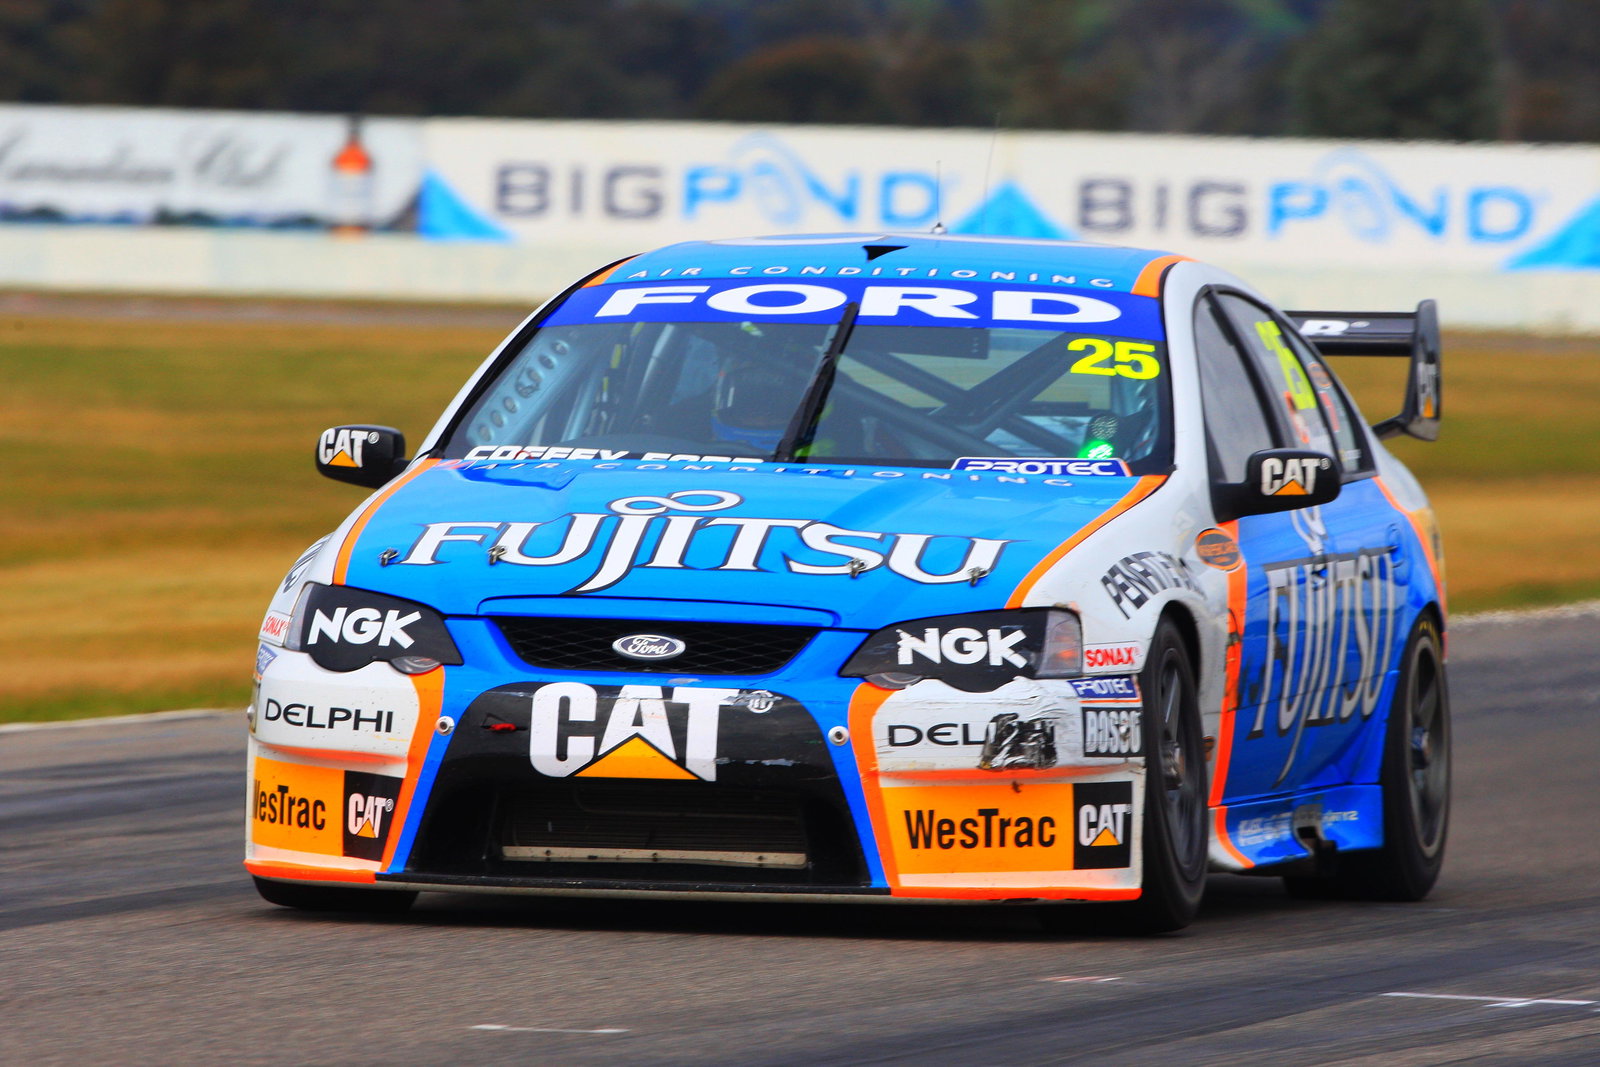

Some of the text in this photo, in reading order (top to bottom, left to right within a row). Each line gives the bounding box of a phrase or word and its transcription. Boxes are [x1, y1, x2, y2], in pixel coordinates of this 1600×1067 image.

[627, 265, 1114, 289] AIR CONDITIONING
[594, 282, 1123, 324] FORD
[1067, 337, 1161, 380] 25
[966, 460, 1117, 477] PROTEC
[400, 510, 1013, 594] FUJITSU
[307, 606, 422, 649] NGK
[627, 636, 669, 657] Ford
[896, 627, 1028, 669] NGK
[1085, 646, 1136, 668] SONAX
[1247, 546, 1400, 786] FUJITSU
[265, 697, 394, 733] DELPHI
[904, 808, 1056, 850] WesTrac
